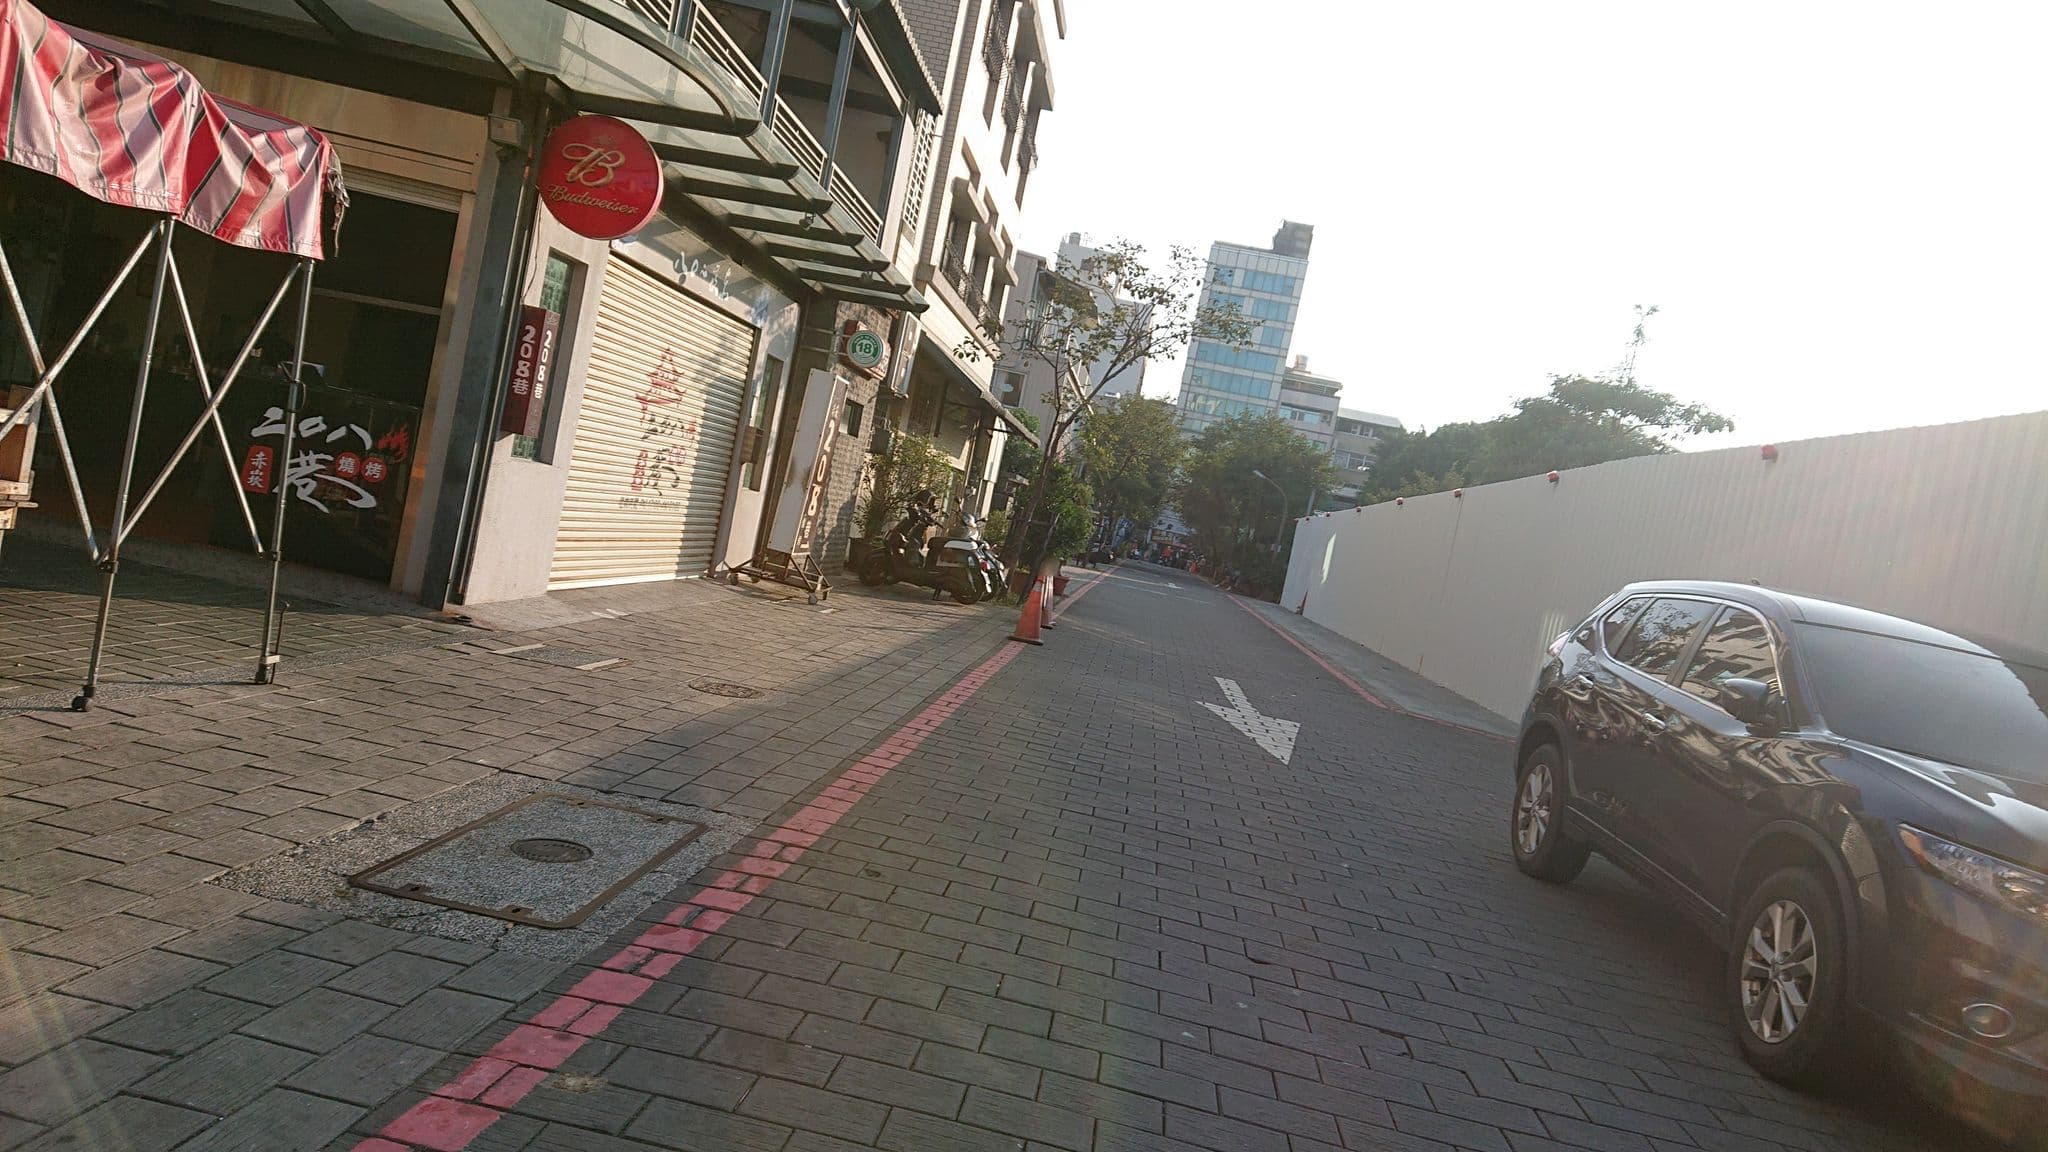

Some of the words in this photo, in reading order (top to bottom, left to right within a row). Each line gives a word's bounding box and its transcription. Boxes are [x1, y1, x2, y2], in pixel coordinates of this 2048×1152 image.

[547, 183, 641, 214] Budweiser
[512, 324, 537, 396] 208巷
[857, 342, 873, 354] 18
[534, 329, 553, 399] 208巷
[337, 455, 383, 479] 燒烤
